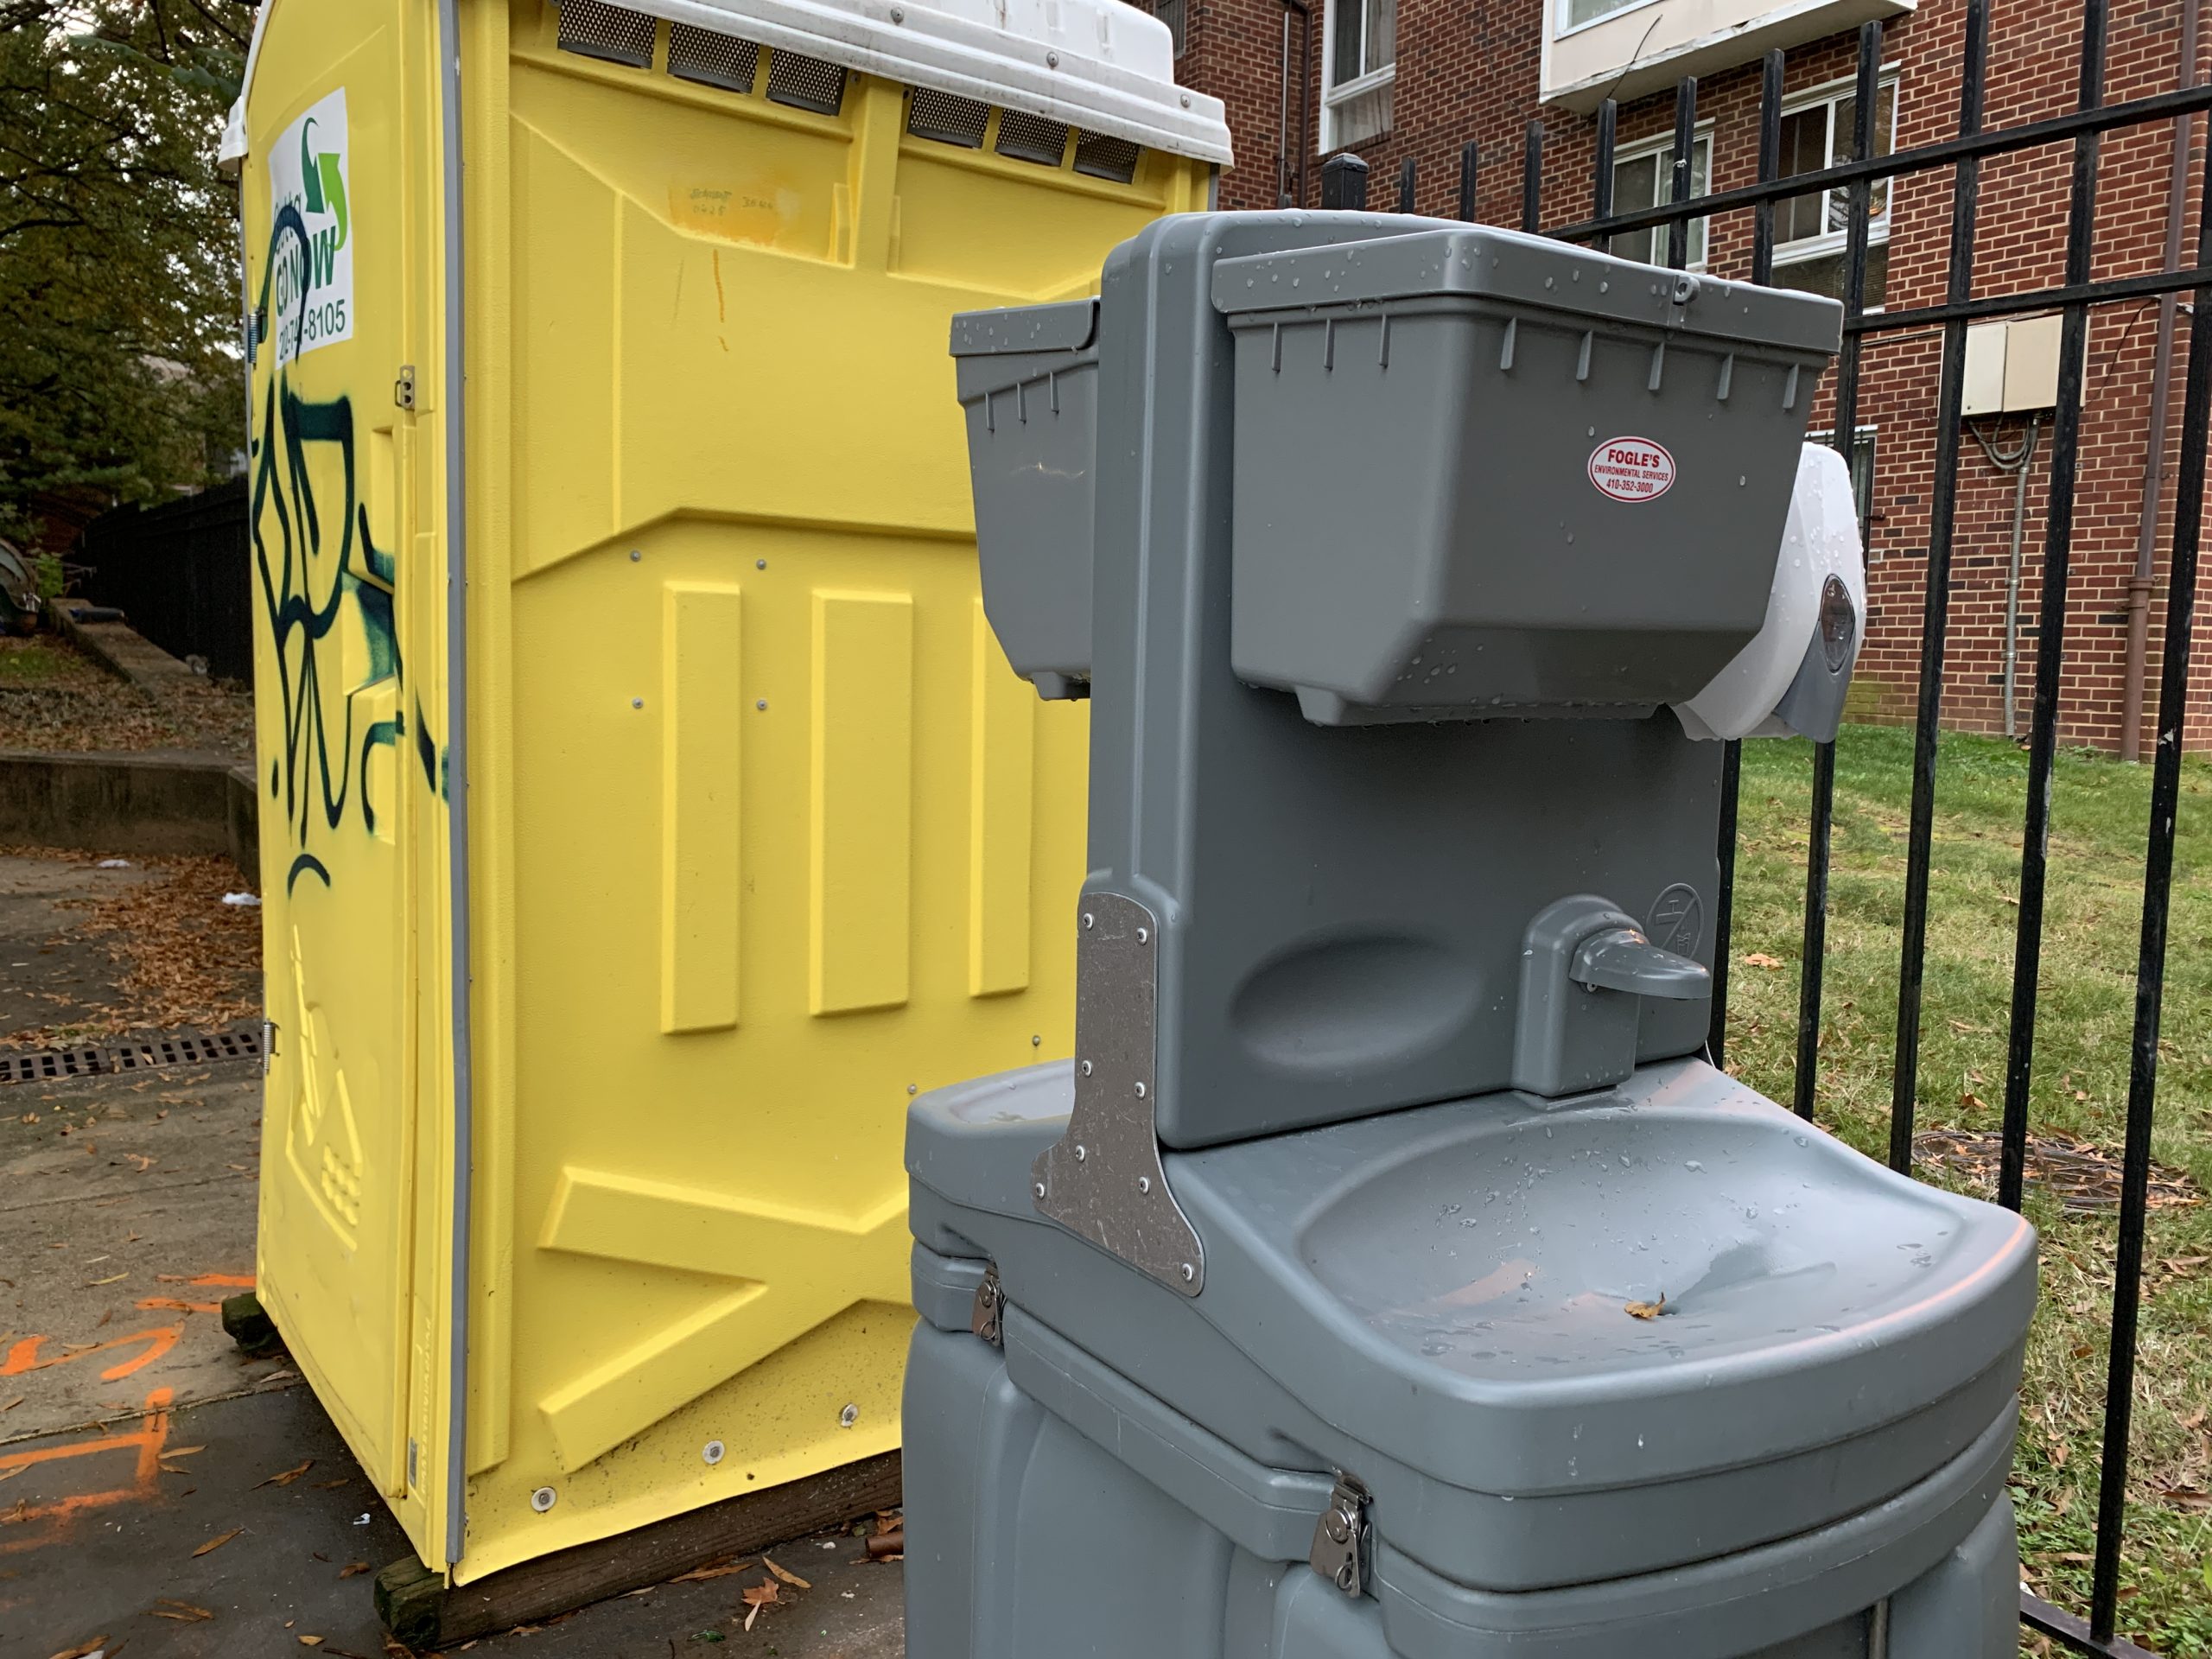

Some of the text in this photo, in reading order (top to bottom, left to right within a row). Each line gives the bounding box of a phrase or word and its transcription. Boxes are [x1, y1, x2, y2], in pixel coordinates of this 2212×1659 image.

[289, 225, 336, 303] NOW
[1607, 448, 1660, 468] FOGLE'S
[1594, 464, 1669, 481] ENVIRONMENTAL SERVICES
[1606, 478, 1654, 493] 410-352-3000
